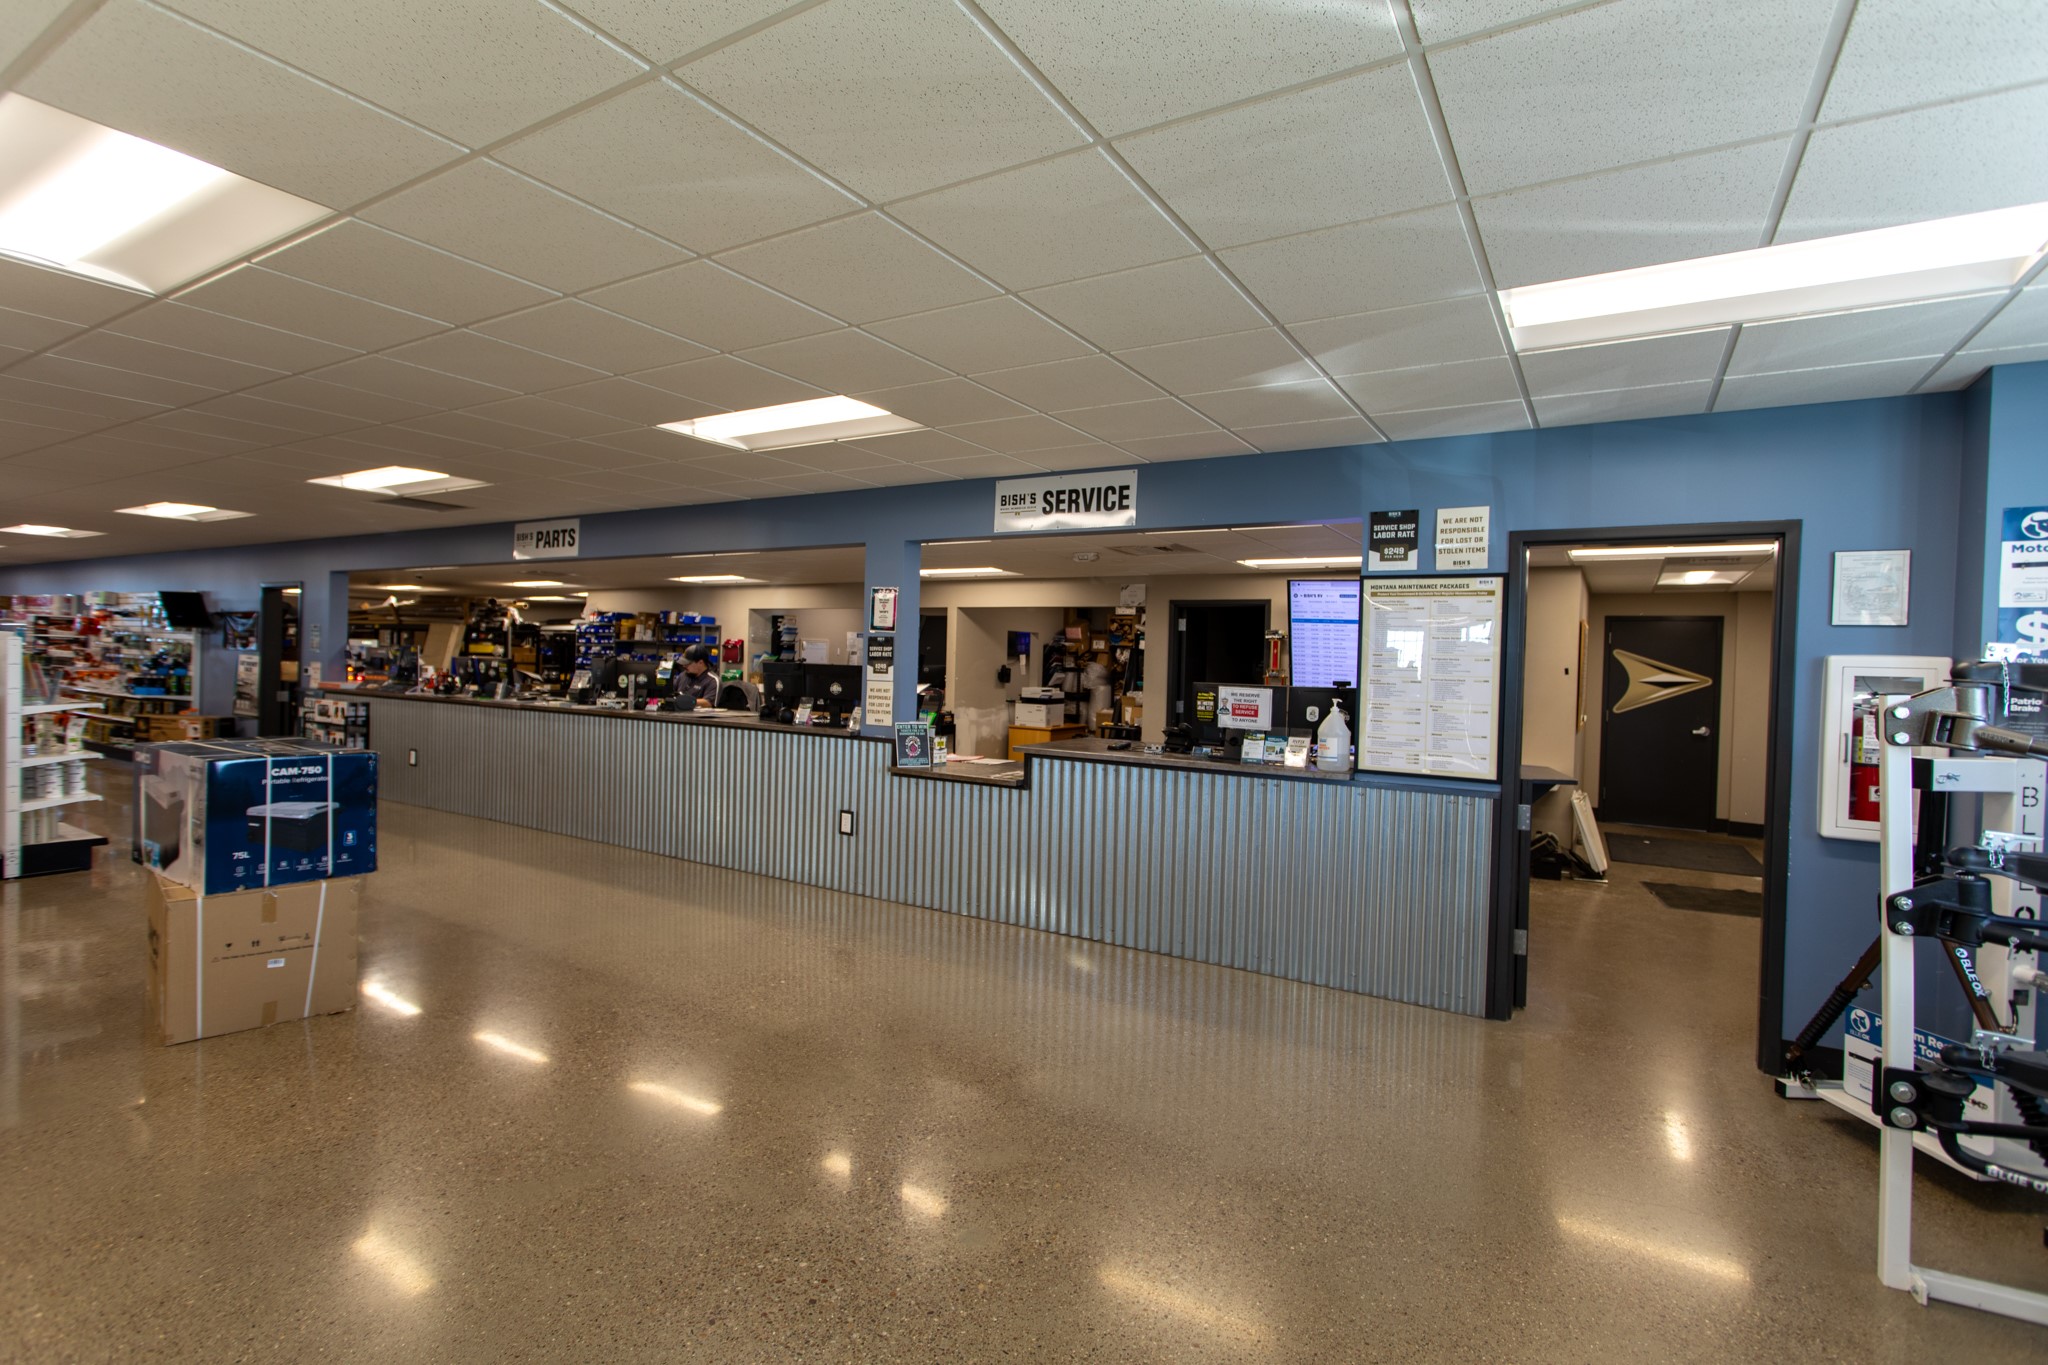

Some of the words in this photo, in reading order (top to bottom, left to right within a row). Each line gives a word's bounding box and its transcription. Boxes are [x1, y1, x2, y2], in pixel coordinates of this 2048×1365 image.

[1000, 492, 1037, 507] BISH'S
[1042, 485, 1130, 515] SERVICE
[1399, 523, 1416, 531] SHOP
[1440, 526, 1485, 535] RESPONSIBLE
[535, 528, 576, 549] PARTS
[1373, 531, 1396, 539] LABOR
[1397, 530, 1415, 538] RATE
[1384, 547, 1405, 555] $249
[1438, 547, 1464, 555] STOLEN
[2010, 697, 2042, 706] Patrio
[2010, 704, 2041, 713] Brake
[271, 765, 323, 777] CAM-750
[291, 775, 329, 784] Refrigerato
[232, 851, 251, 860] 75L
[1987, 1165, 2029, 1188] BLUE
